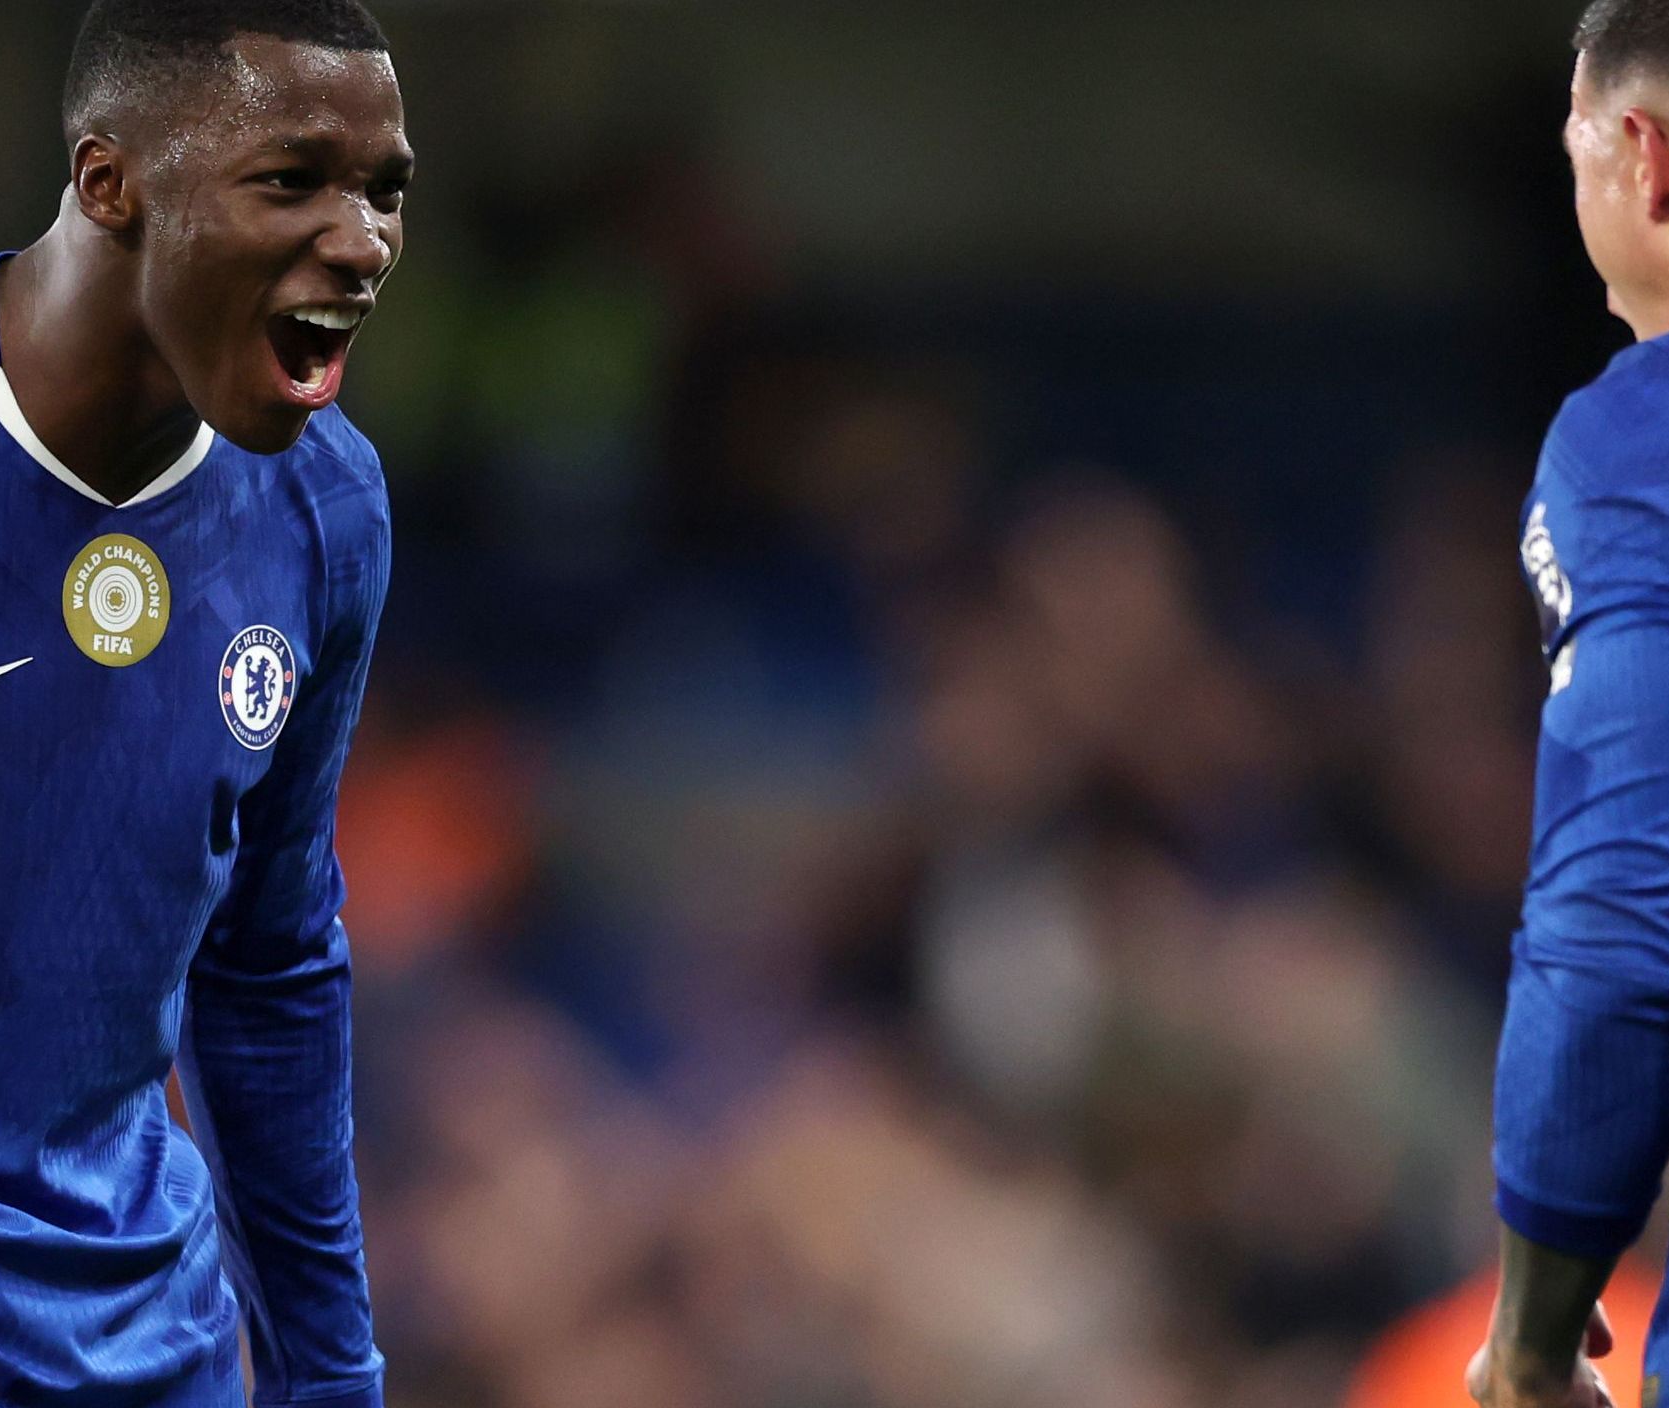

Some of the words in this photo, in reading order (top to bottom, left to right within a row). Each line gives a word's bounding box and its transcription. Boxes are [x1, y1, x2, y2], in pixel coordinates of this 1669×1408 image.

[73, 553, 101, 610] WORLD
[104, 545, 160, 619] CHAMPIONS
[93, 633, 132, 655] FIFA
[234, 630, 286, 658] CHELSEA
